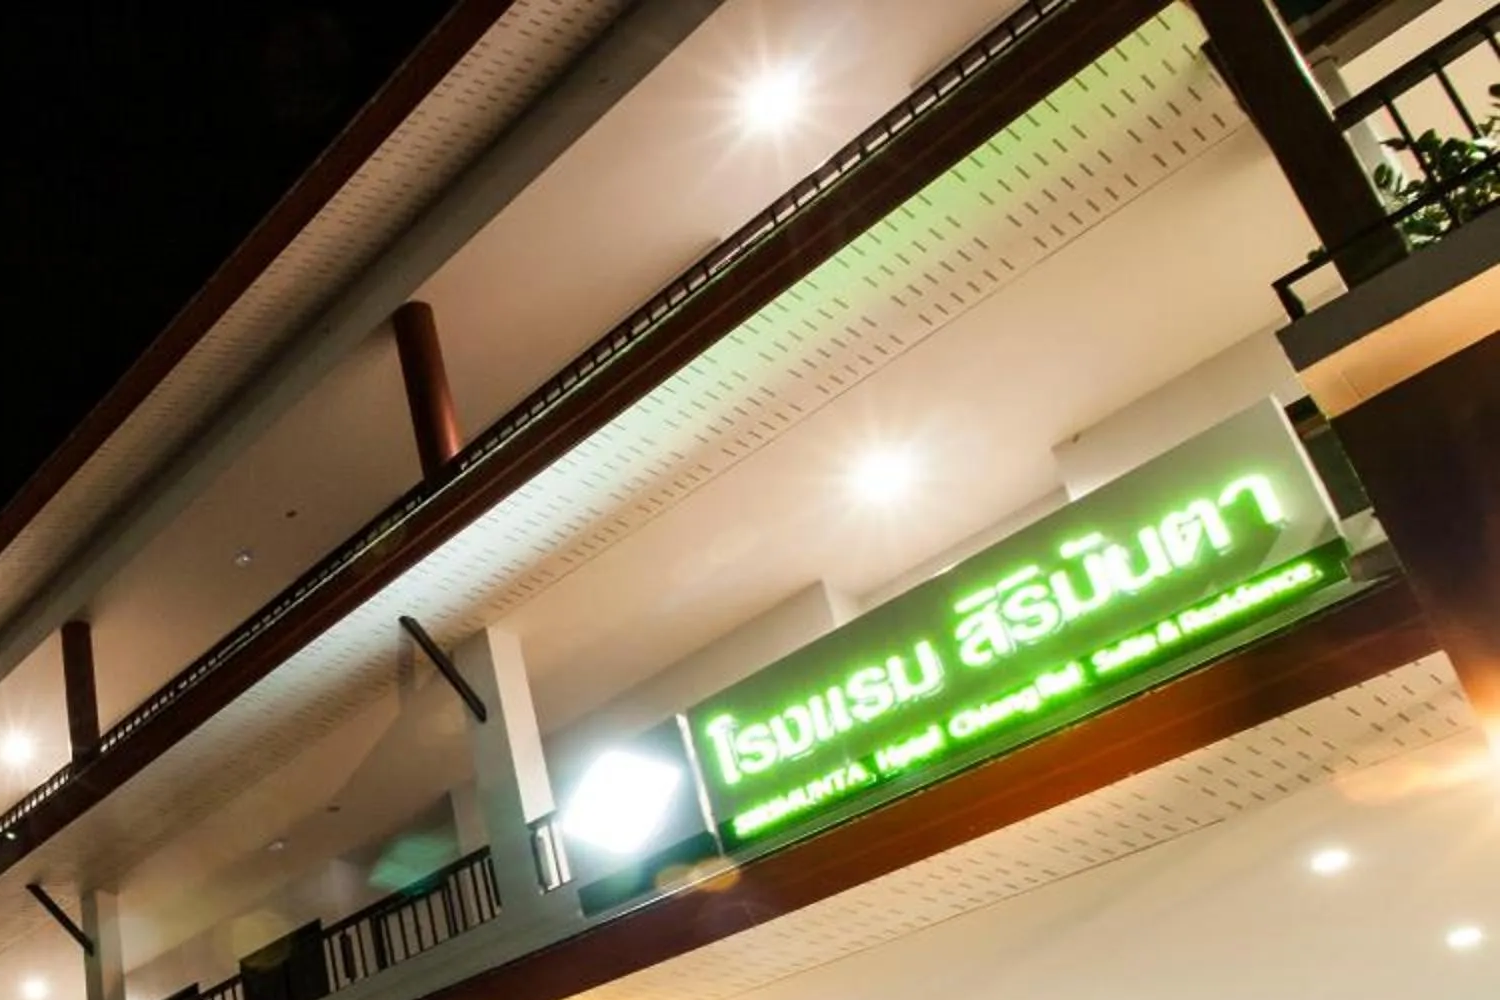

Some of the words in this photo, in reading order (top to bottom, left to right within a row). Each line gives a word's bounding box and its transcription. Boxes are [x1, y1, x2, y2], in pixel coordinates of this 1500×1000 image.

[1155, 621, 1180, 643] &
[704, 638, 945, 786] โรงแรม
